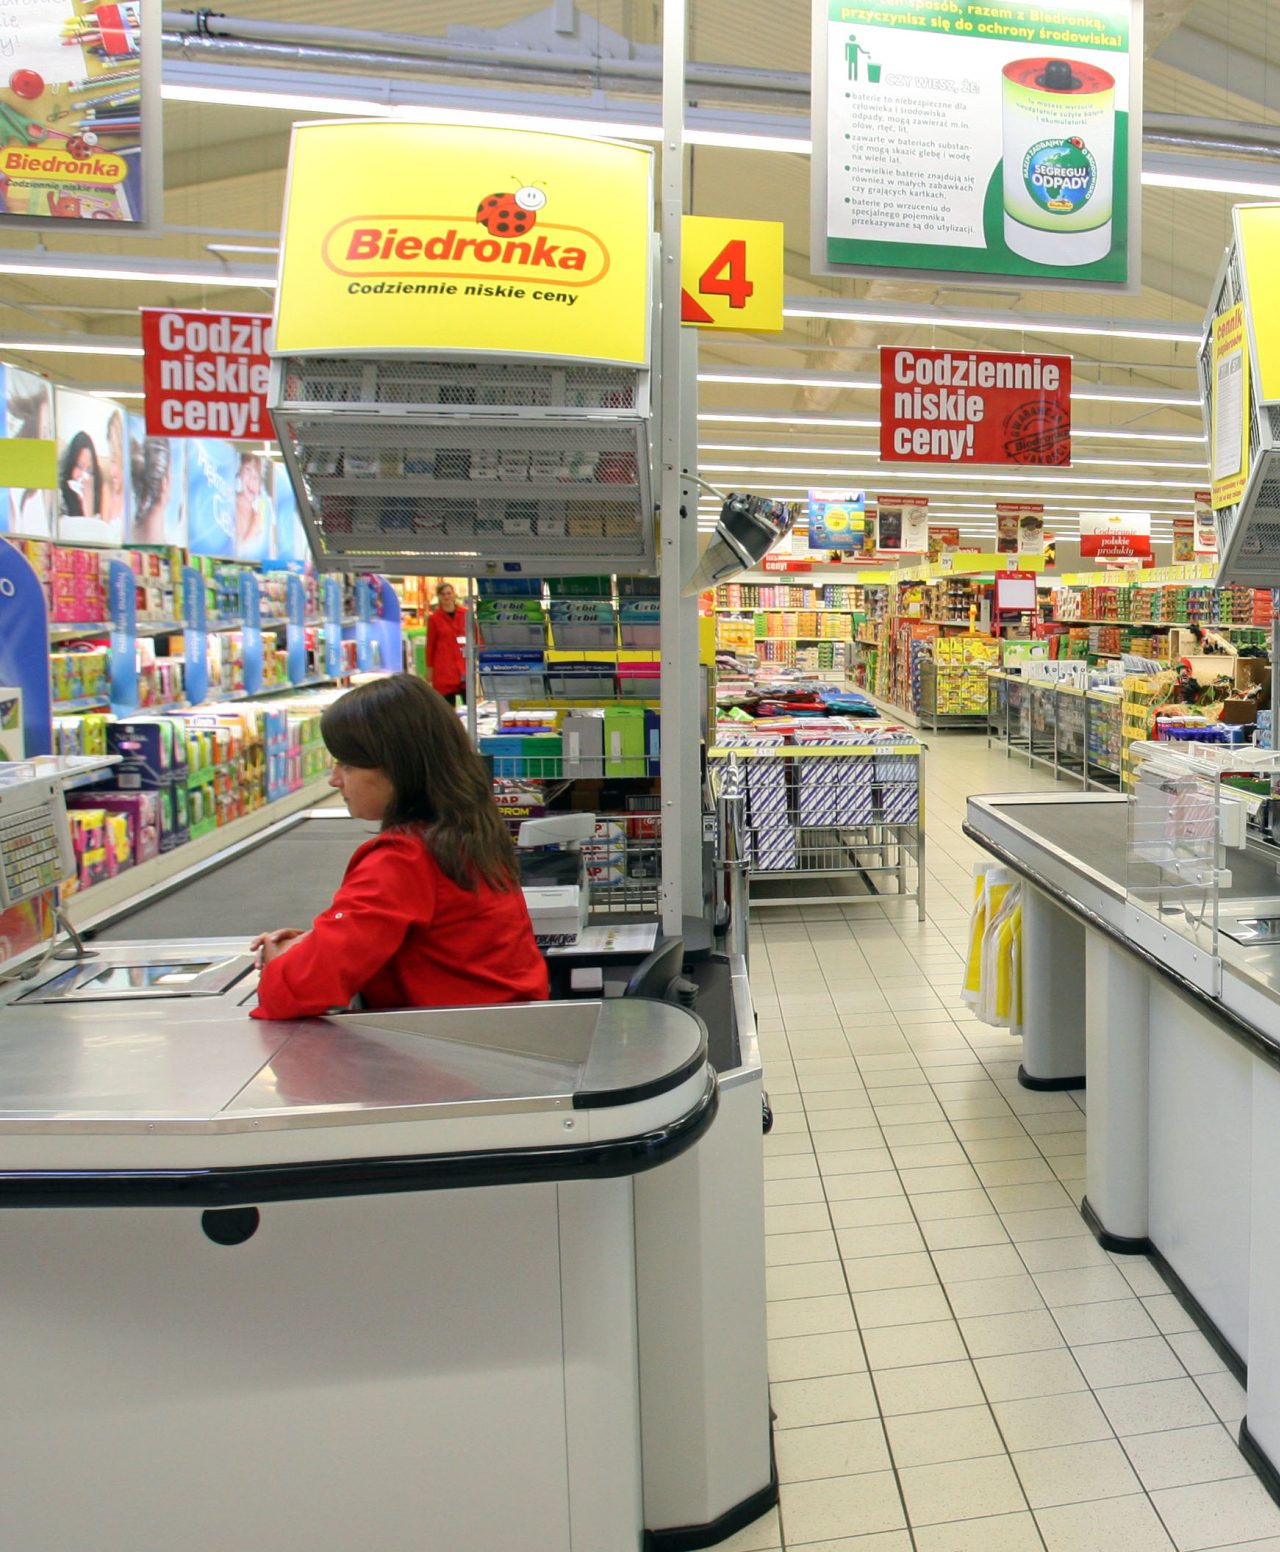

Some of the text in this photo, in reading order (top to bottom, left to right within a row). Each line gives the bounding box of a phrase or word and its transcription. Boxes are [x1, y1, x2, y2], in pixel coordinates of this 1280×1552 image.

[841, 6, 1122, 47] przyczynisz się do ochrony środowiska!
[968, 5, 1013, 19] razem
[1016, 10, 1025, 20] z
[1031, 9, 1106, 32] Biedronką,
[885, 73, 913, 88] CZY
[852, 92, 967, 110] baterie to niebezpieczne dla
[852, 103, 946, 118] człowieka środowiska
[887, 116, 910, 126] mogą
[913, 116, 948, 128] zawierać
[852, 134, 885, 144] zawarte
[898, 137, 936, 149] bateriach
[852, 144, 971, 162] cje mogą skazić glebę wodę
[852, 153, 862, 161] na
[865, 153, 886, 162] wiele
[5, 152, 120, 178] Biedronka
[1034, 164, 1087, 177] SEGREGUJ
[852, 165, 975, 184] niewielkie baterie znajdują się
[1032, 173, 1090, 190] ODPADY
[852, 175, 974, 191] również małych zabawkach
[852, 185, 907, 197] czy grających
[852, 197, 951, 213] baterie po wrzuceniu do
[852, 207, 945, 222] specjalnego pojemnika
[852, 218, 975, 234] przekazywane są do utylizacji.
[345, 228, 587, 272] Biedronka
[700, 239, 754, 309] 4
[347, 281, 579, 306] Codziennie niskie ceny
[1216, 306, 1243, 341] cennik
[160, 354, 270, 394] niskie
[894, 350, 1060, 391] Codziennie
[894, 387, 984, 422] niskie
[161, 396, 260, 437] ceny!
[893, 424, 974, 460] ceny!
[1101, 535, 1130, 547] polskie
[1097, 546, 1134, 556] produkty
[493, 601, 525, 610] Orbit
[566, 603, 597, 611] Orbit
[496, 613, 528, 621] Orbit
[567, 613, 598, 622] Orbit
